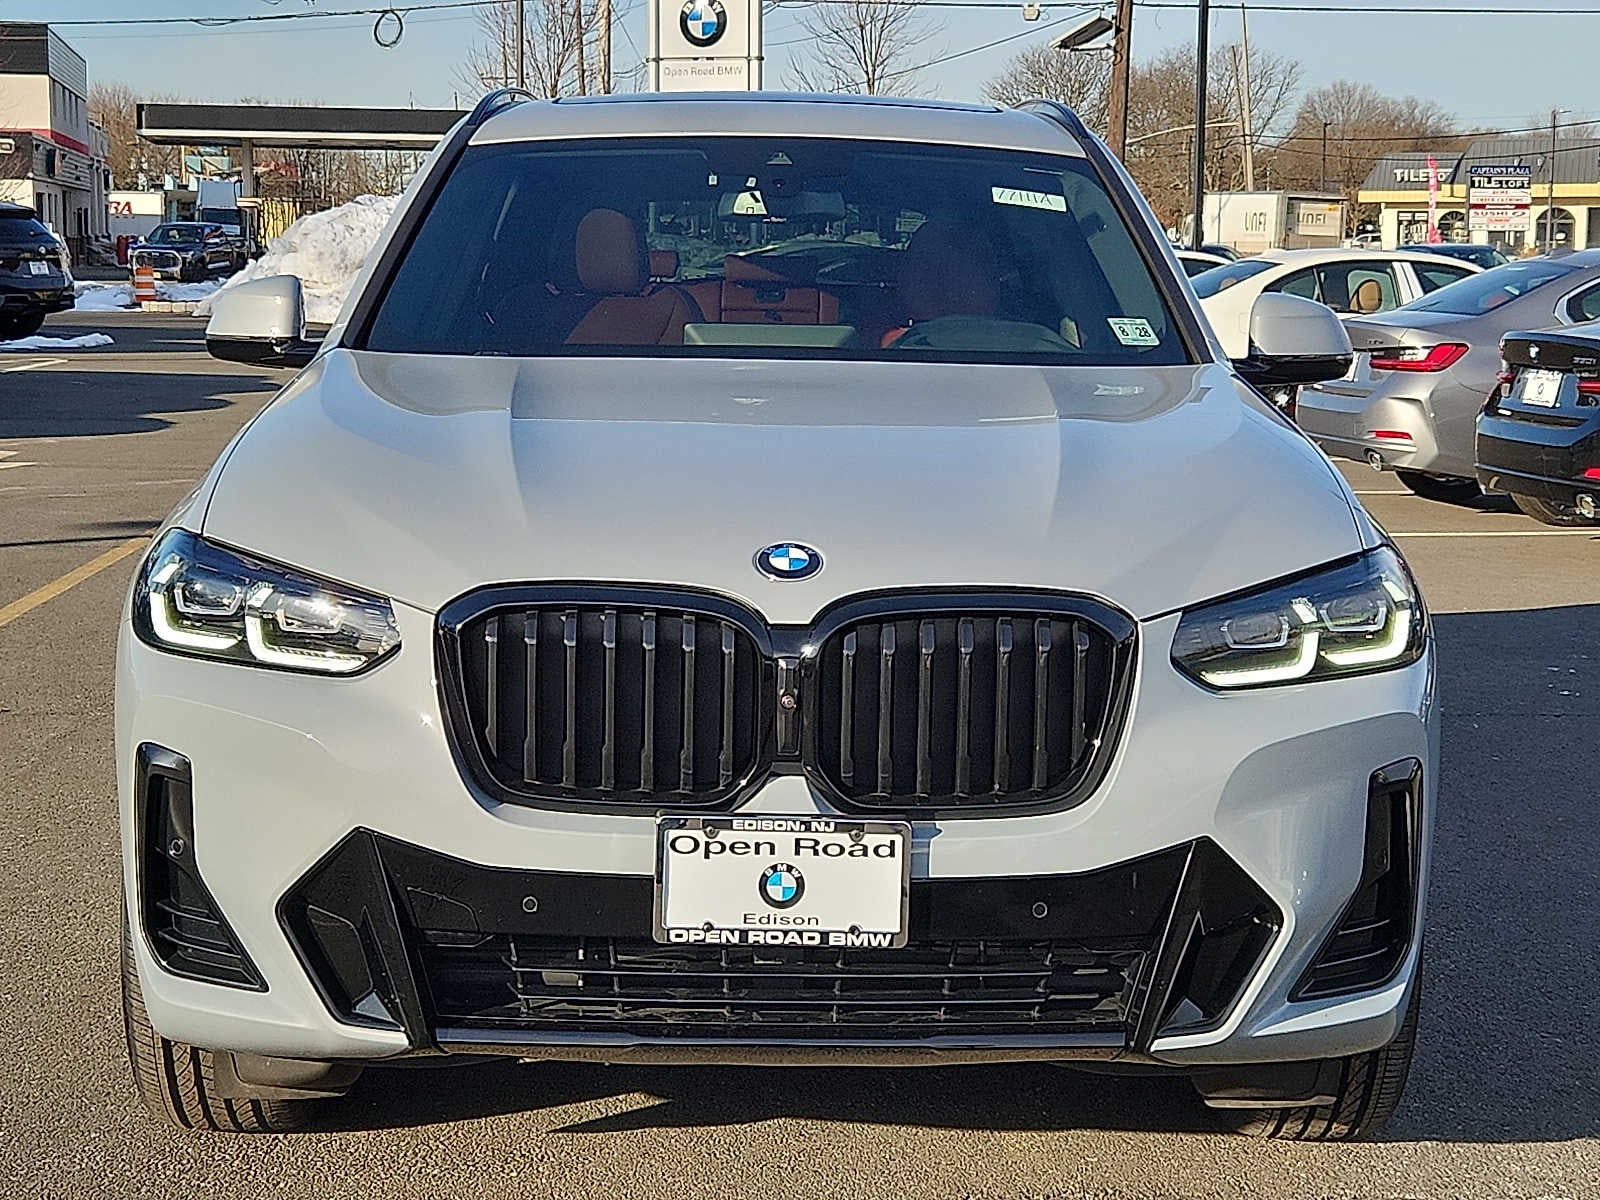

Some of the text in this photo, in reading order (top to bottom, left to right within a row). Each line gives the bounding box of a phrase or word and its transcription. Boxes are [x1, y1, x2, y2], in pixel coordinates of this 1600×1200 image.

[664, 66, 743, 77] Open Road BMW
[1393, 168, 1429, 182] TILE
[1472, 177, 1530, 188] TILE LOFT
[1119, 326, 1152, 338] 8 28
[732, 820, 835, 832] EDISON, NJ
[669, 835, 896, 860] Open Road
[764, 863, 802, 878] BMW
[743, 912, 820, 926] Edison
[669, 929, 893, 947] OPEN ROAD BMW
